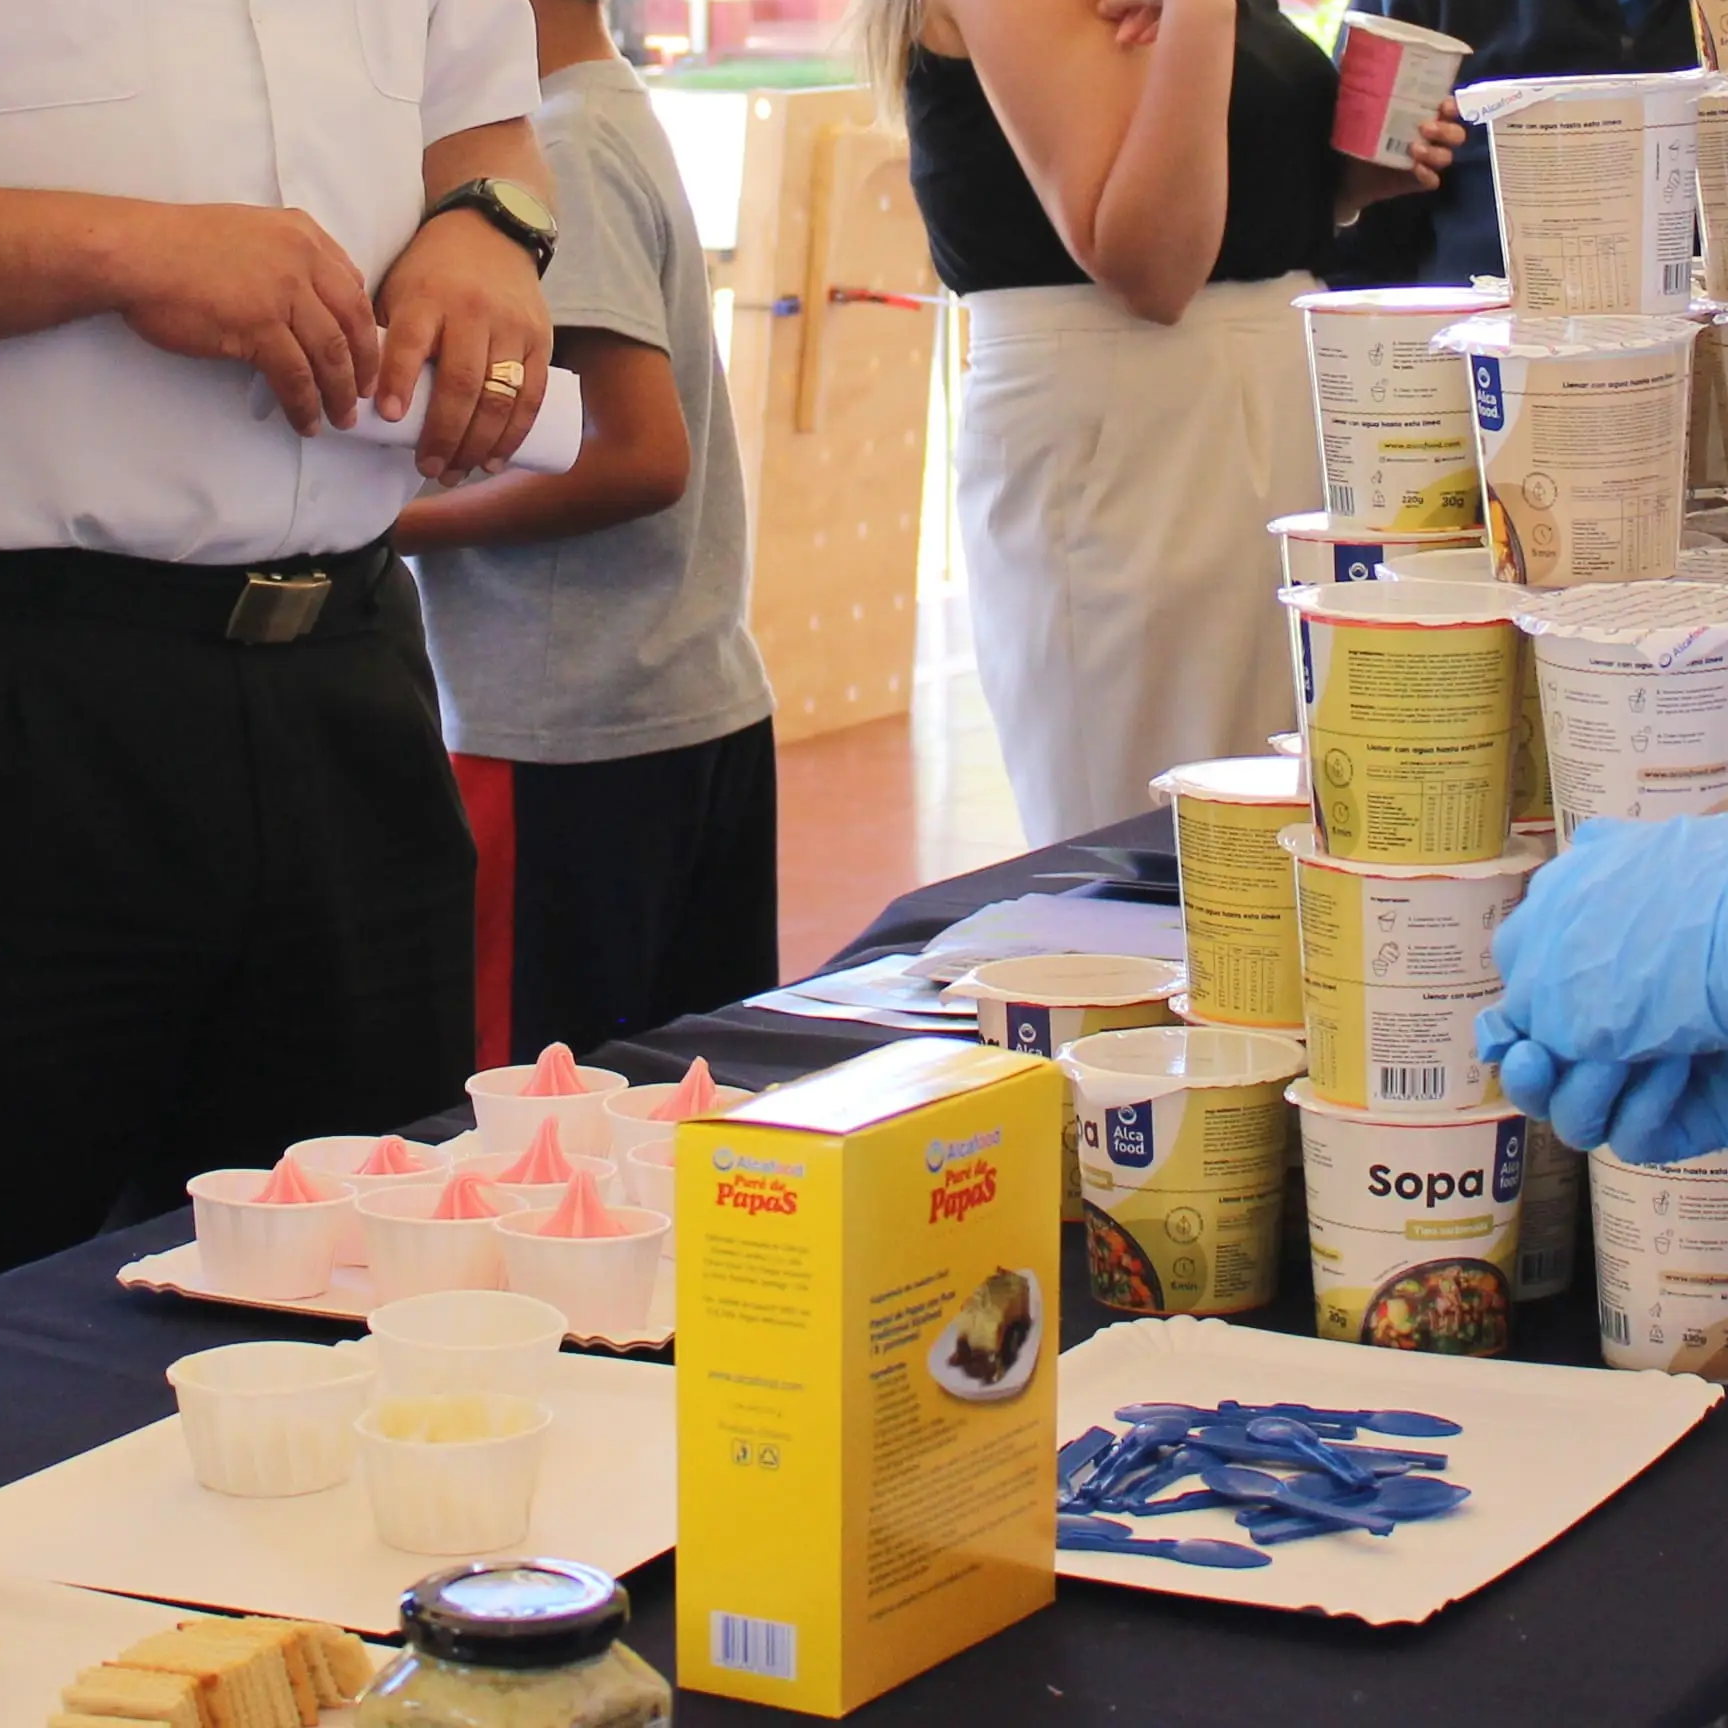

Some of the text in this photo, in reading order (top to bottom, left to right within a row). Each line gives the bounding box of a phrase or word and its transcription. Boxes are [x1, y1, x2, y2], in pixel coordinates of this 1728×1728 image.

[1563, 380, 1589, 390] Llenar
[1539, 548, 1556, 557] min
[1394, 745, 1410, 753] con
[1422, 993, 1449, 1001] Llenar
[1450, 992, 1465, 1000] con
[1113, 1125, 1143, 1142] Alca
[945, 1127, 1002, 1160] Alcafood
[1113, 1139, 1144, 1155] food
[736, 1155, 805, 1178] Alcafood
[975, 1159, 989, 1177] de
[1500, 1160, 1521, 1176] Alca
[769, 1177, 787, 1191] de
[1368, 1163, 1485, 1209] Sopa
[1413, 1225, 1434, 1238] Tipo
[1328, 1309, 1348, 1328] 30g
